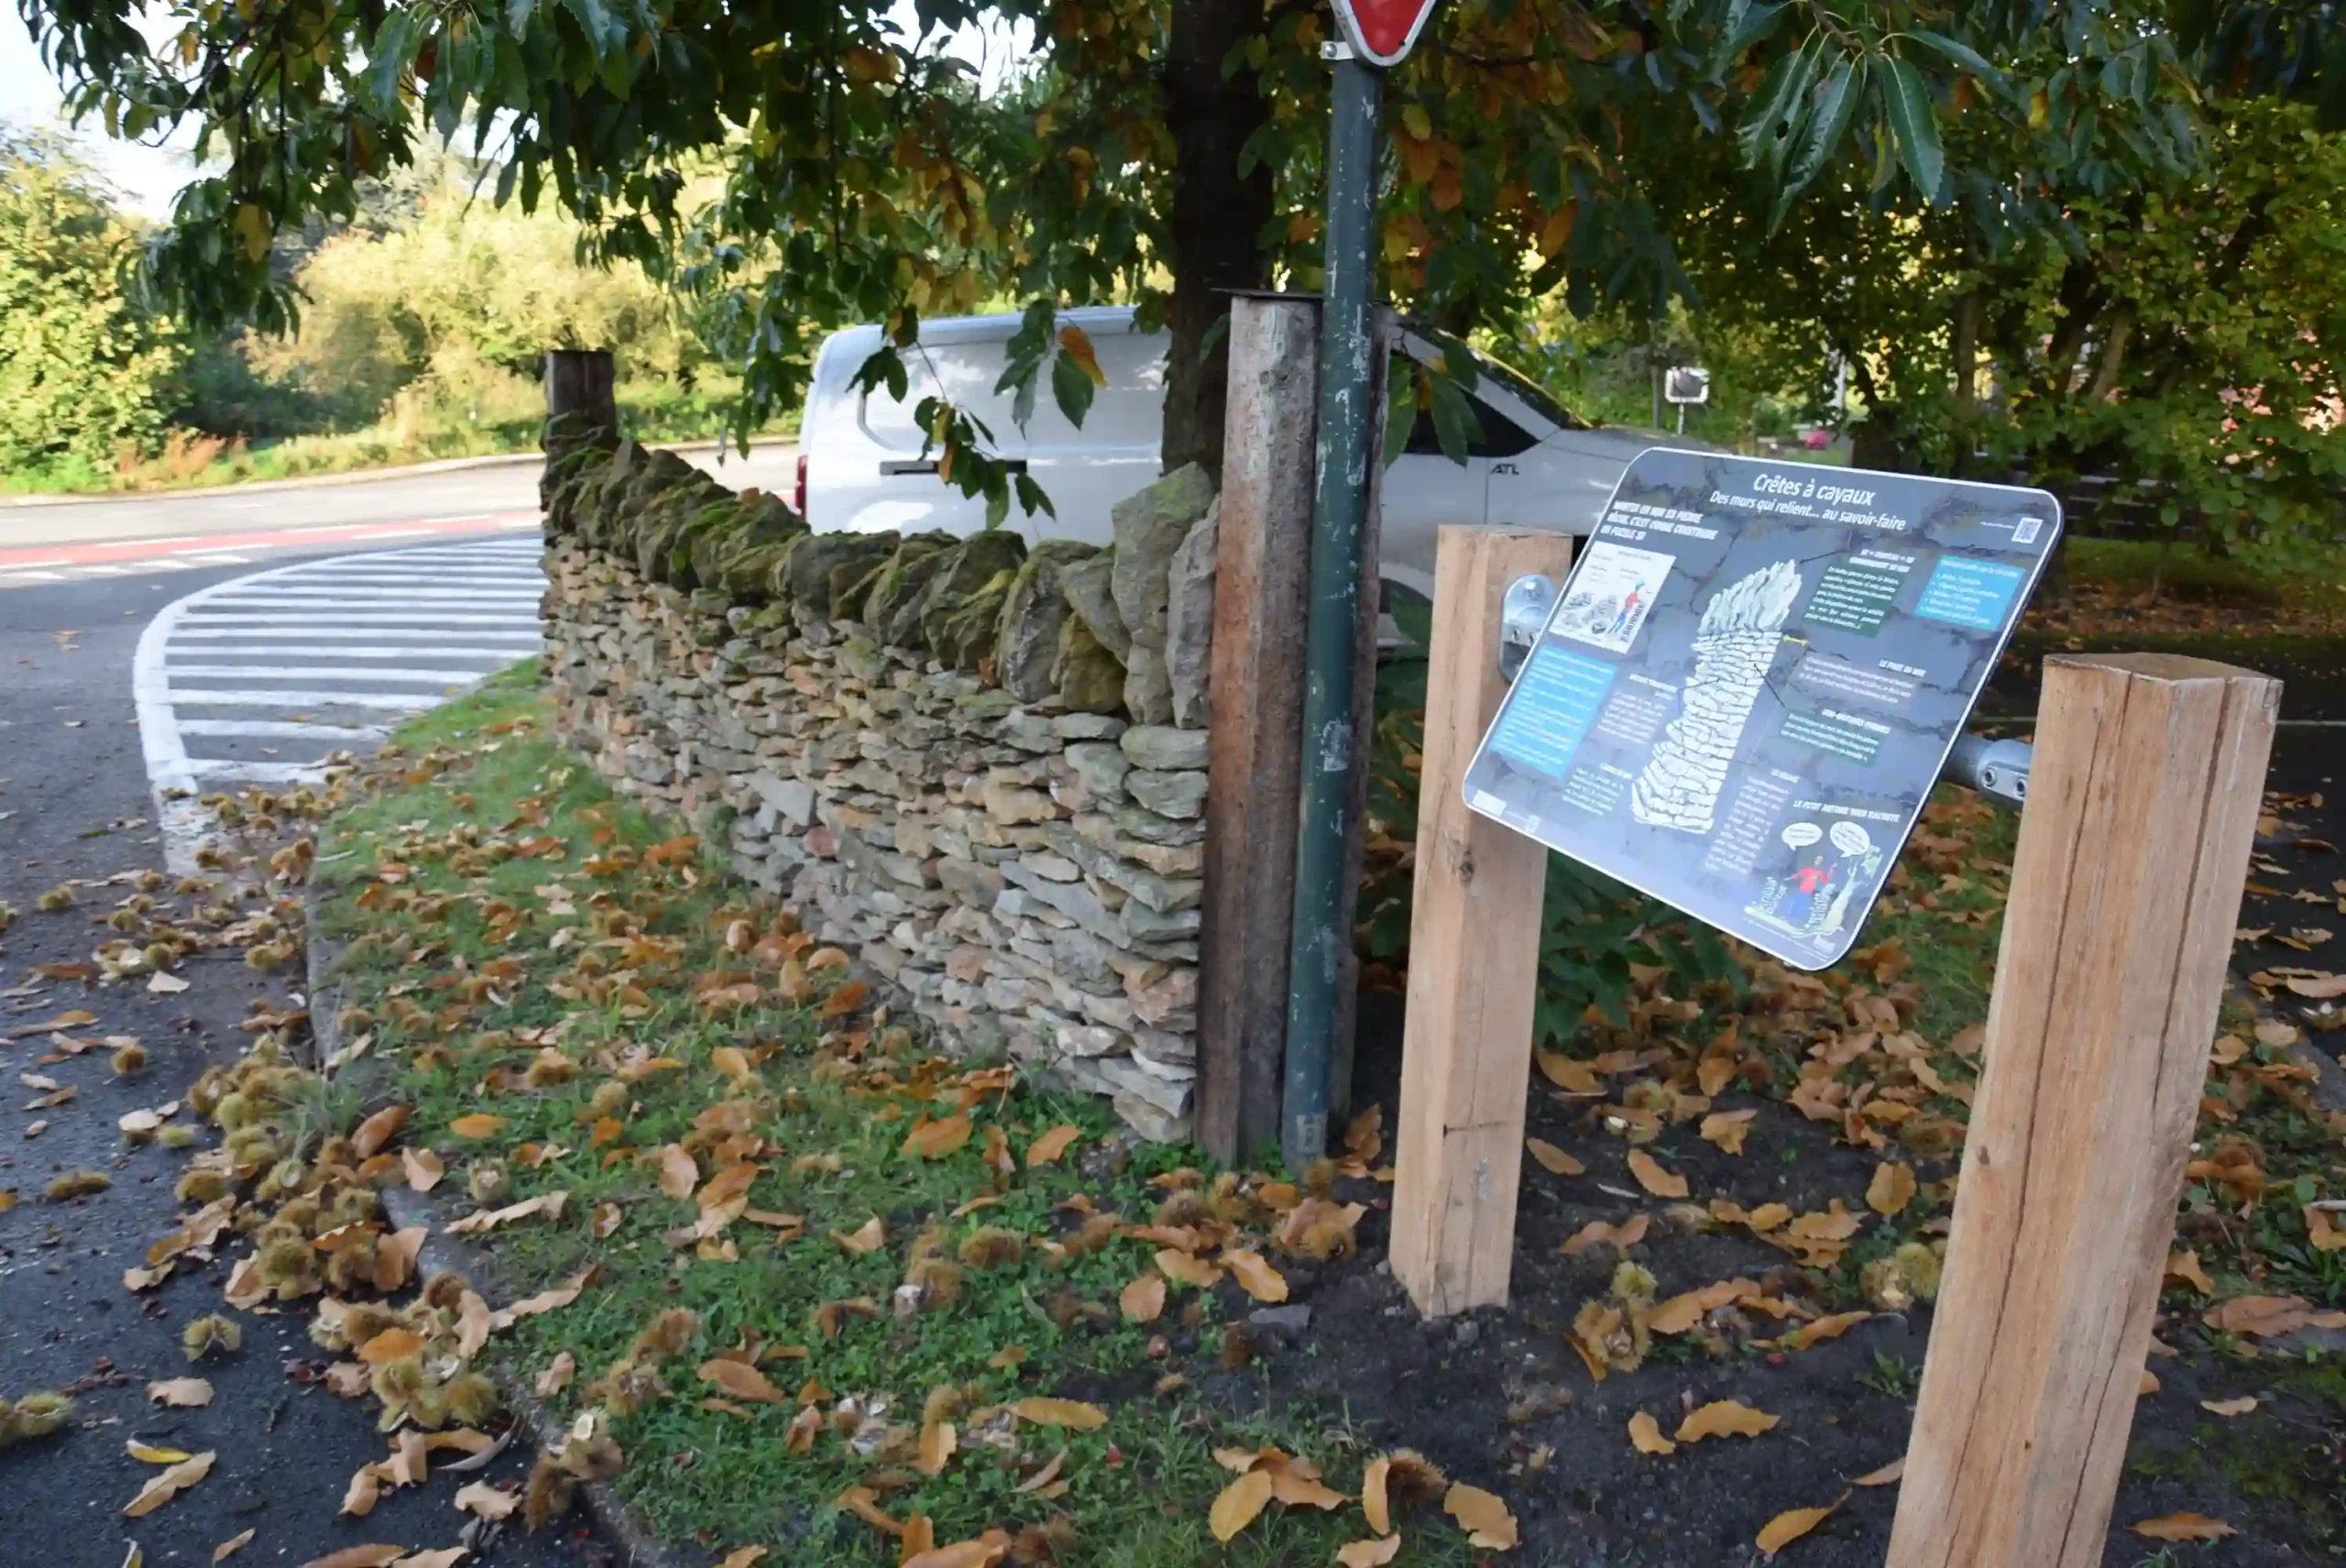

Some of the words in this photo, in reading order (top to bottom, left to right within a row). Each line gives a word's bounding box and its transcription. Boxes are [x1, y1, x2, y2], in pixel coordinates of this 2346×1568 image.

[1752, 473, 1803, 497] Crêtes
[1802, 478, 1816, 499] à
[1816, 484, 1877, 506] cayaux
[1710, 490, 1729, 504] Des
[1729, 496, 1755, 510] murs
[1756, 499, 1775, 512] qui
[1774, 501, 1820, 519] relient...
[1822, 508, 1839, 521] au
[1838, 510, 1907, 532] savoir-faire
